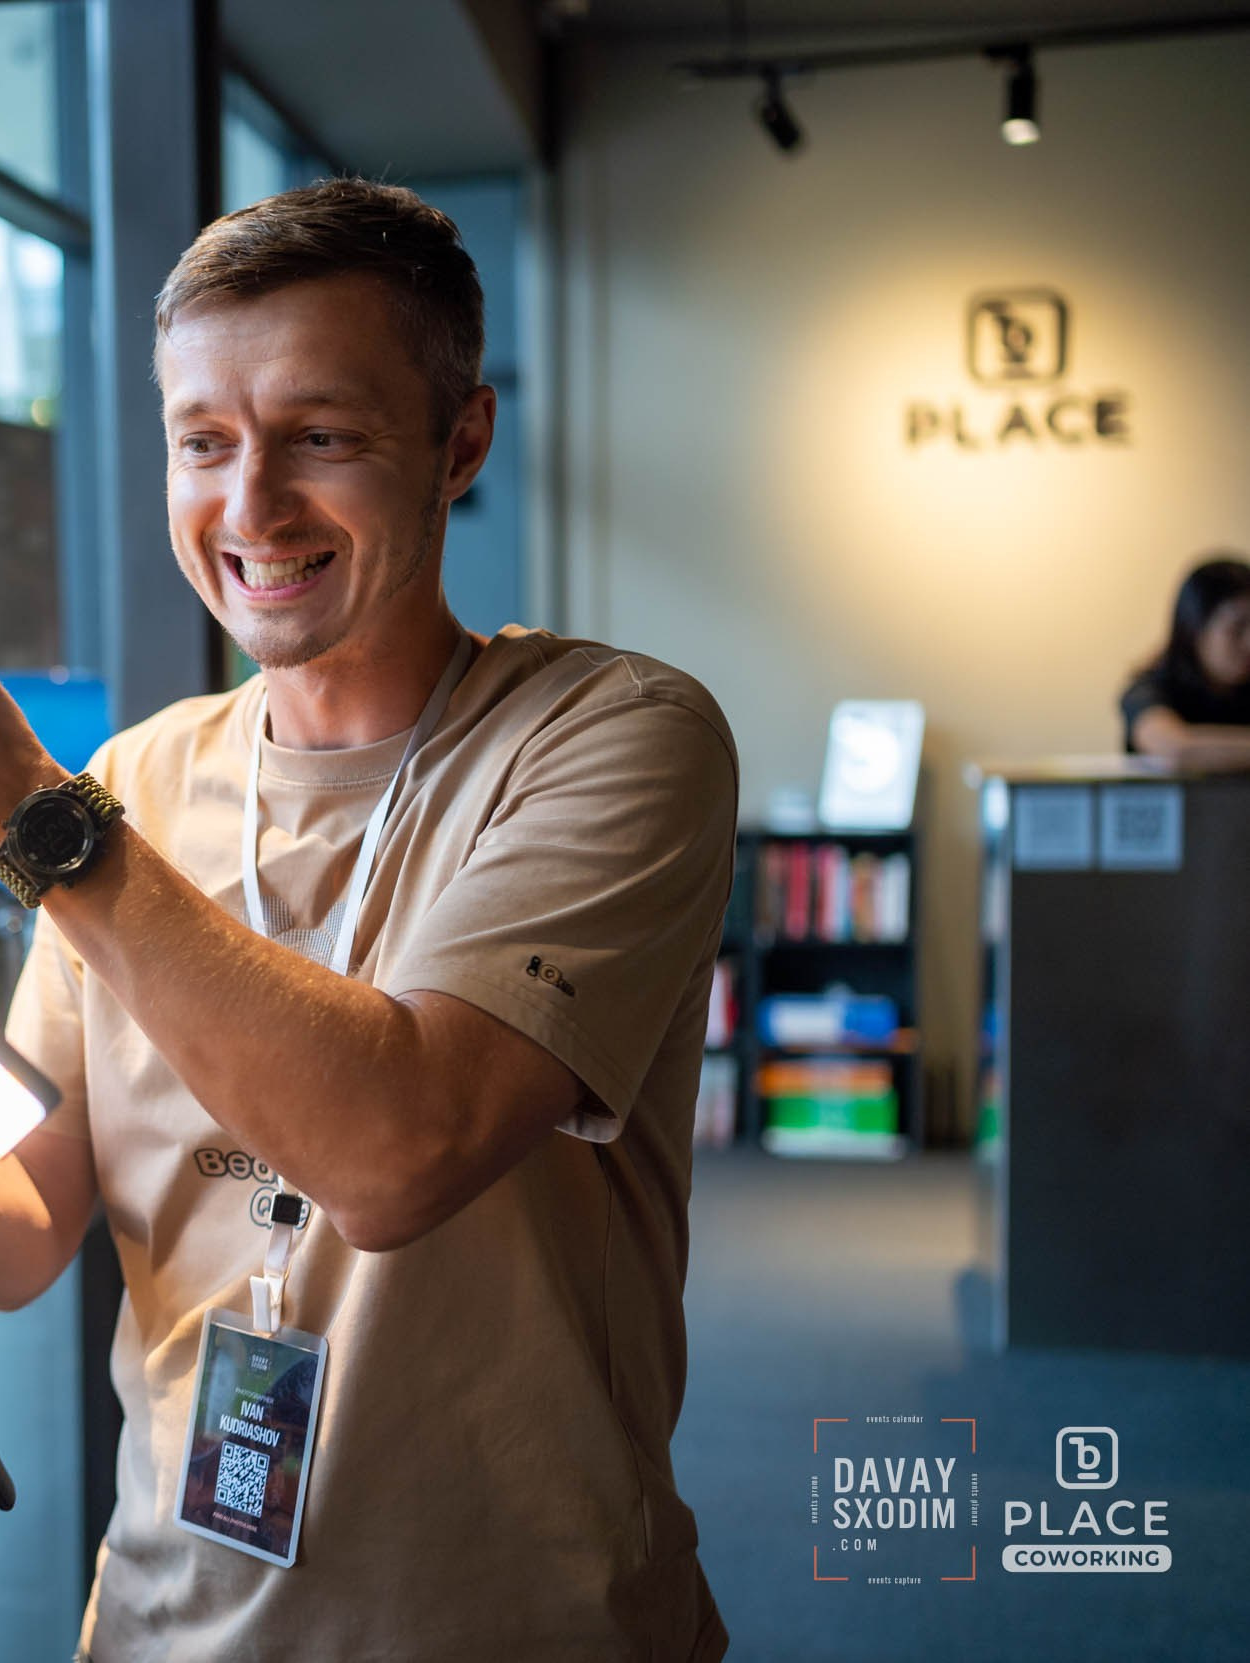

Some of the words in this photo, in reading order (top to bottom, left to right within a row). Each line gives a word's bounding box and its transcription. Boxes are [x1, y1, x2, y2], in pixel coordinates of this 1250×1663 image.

[906, 392, 1130, 449] PLACE
[240, 1400, 264, 1422] IVAN
[219, 1414, 280, 1447] KUDRIASHOV
